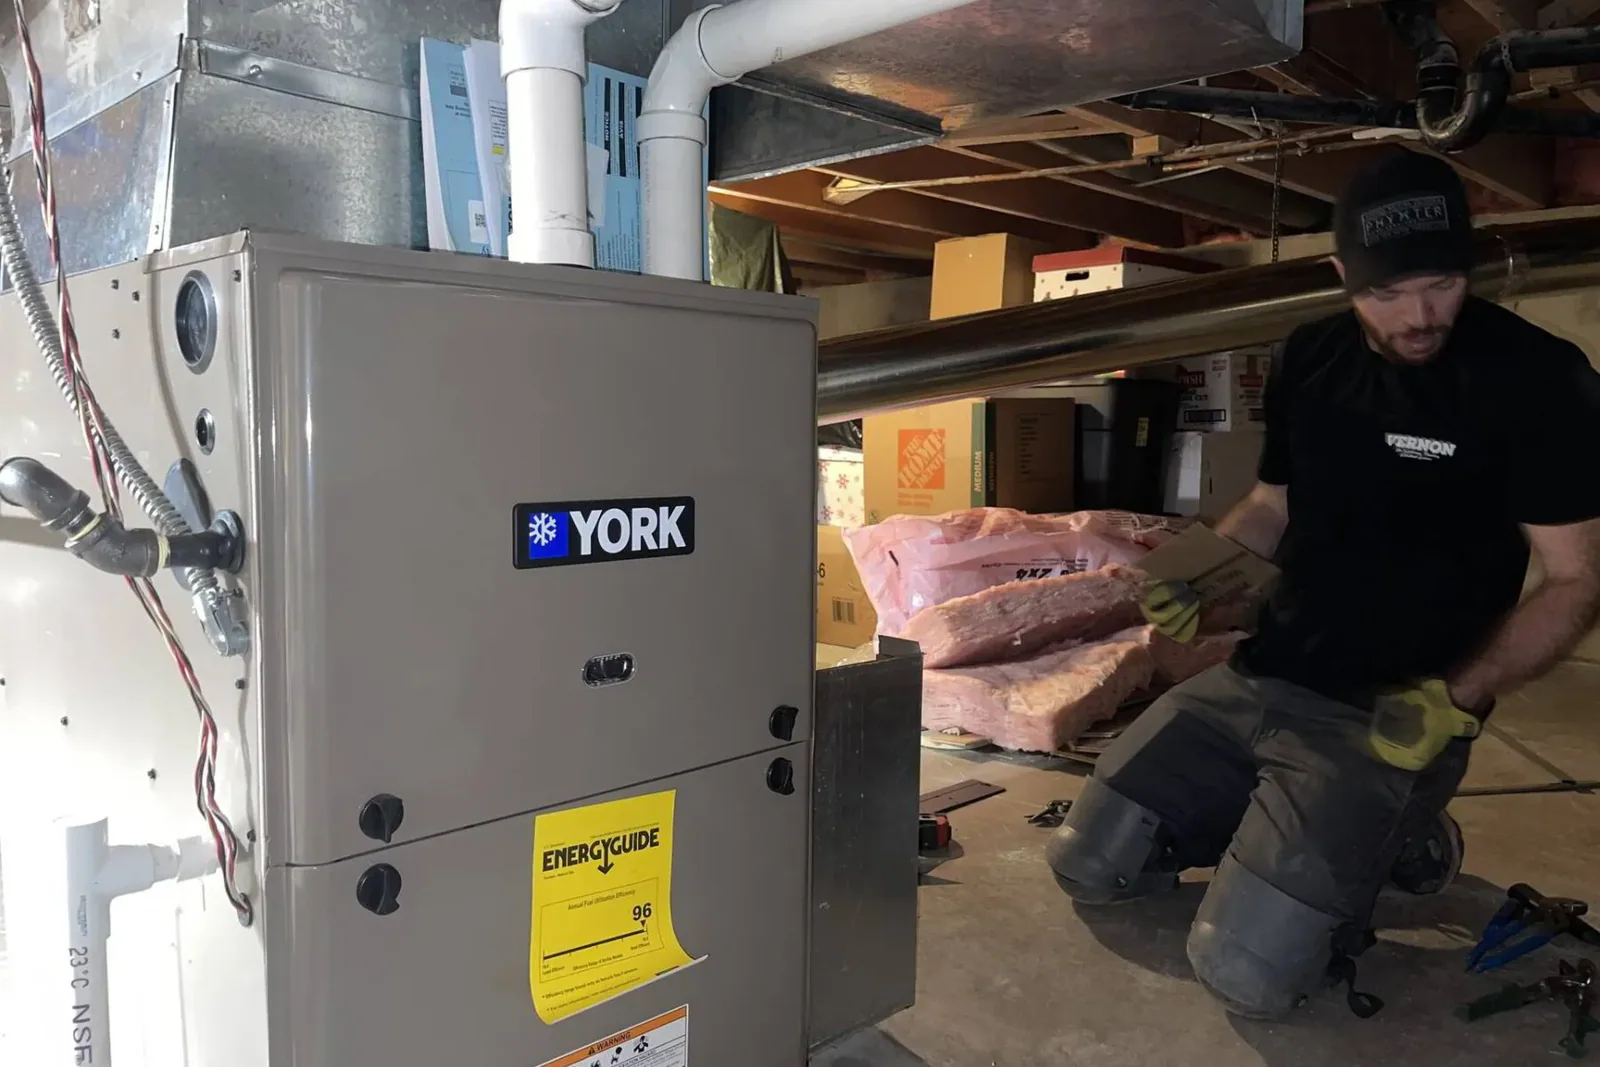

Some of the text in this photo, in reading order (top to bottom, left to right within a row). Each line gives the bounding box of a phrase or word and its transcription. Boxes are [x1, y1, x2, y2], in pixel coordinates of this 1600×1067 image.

[898, 429, 946, 489] HOME
[1384, 432, 1457, 457] VERNON
[974, 451, 983, 493] MEDIUM
[569, 505, 686, 556] YORK
[542, 827, 660, 874] ENERGYGUIDE
[632, 902, 652, 921] 96
[68, 946, 90, 990] 23°C
[72, 1003, 93, 1066] NSF
[596, 1031, 631, 1051] WARNING
